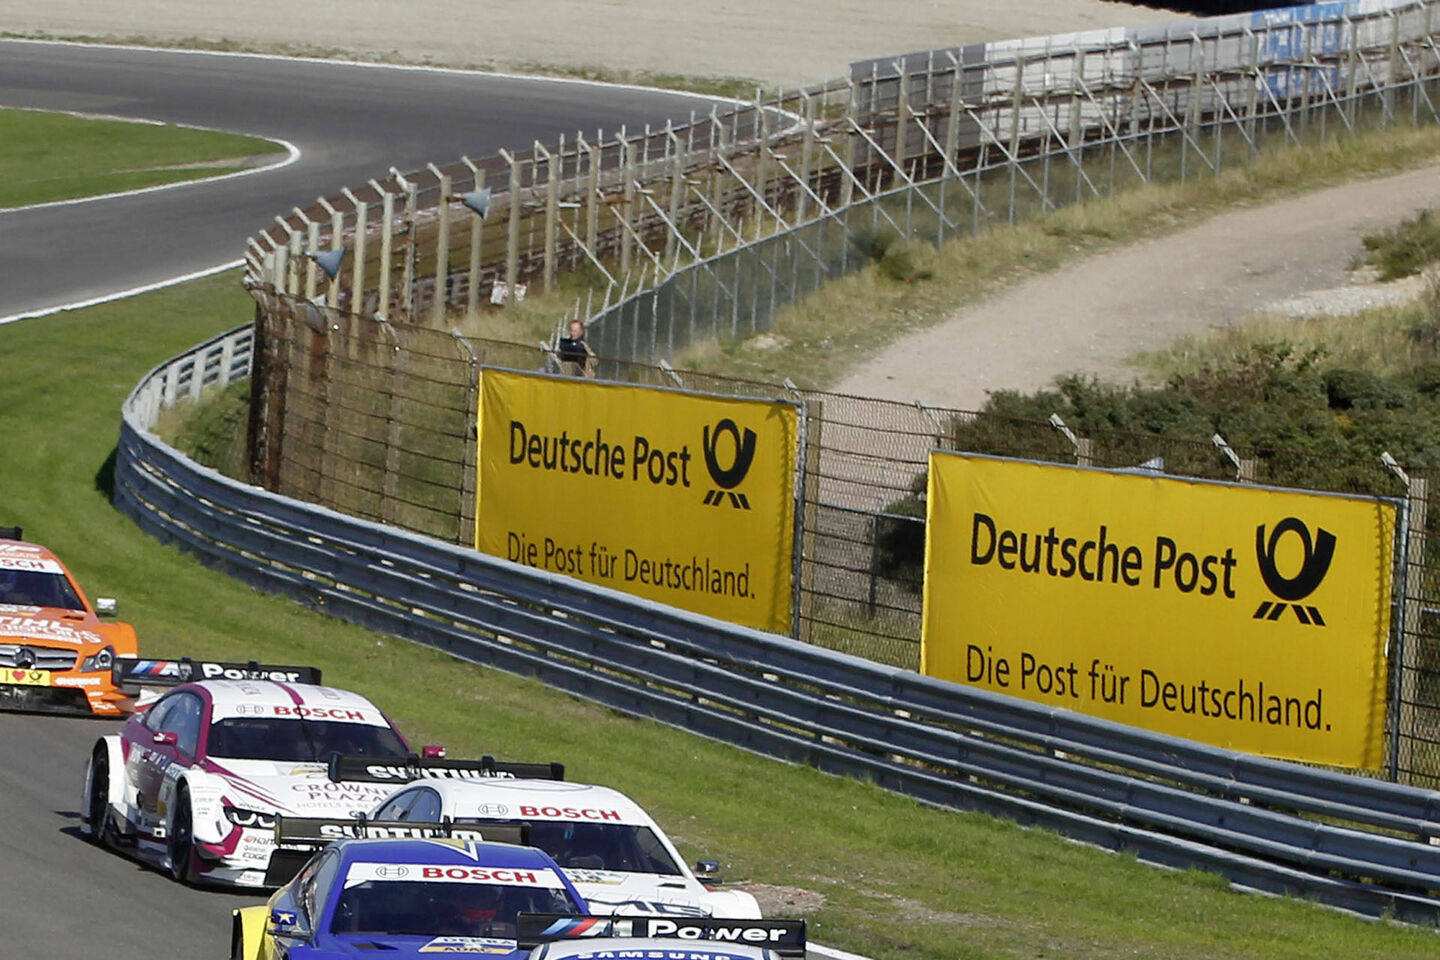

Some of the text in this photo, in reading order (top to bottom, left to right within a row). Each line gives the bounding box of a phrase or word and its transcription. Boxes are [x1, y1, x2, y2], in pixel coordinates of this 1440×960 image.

[510, 420, 692, 487] Deutsche Post
[508, 531, 756, 600] Die Post für Deutschland.
[971, 512, 1238, 599] Deutsche Post
[201, 663, 301, 683] Power
[967, 644, 1333, 732] Die Post für Deutschland.
[273, 705, 366, 721] BOSCH
[519, 805, 622, 821] BOSCH
[422, 867, 538, 884] BOSCH
[647, 919, 789, 942] Power
